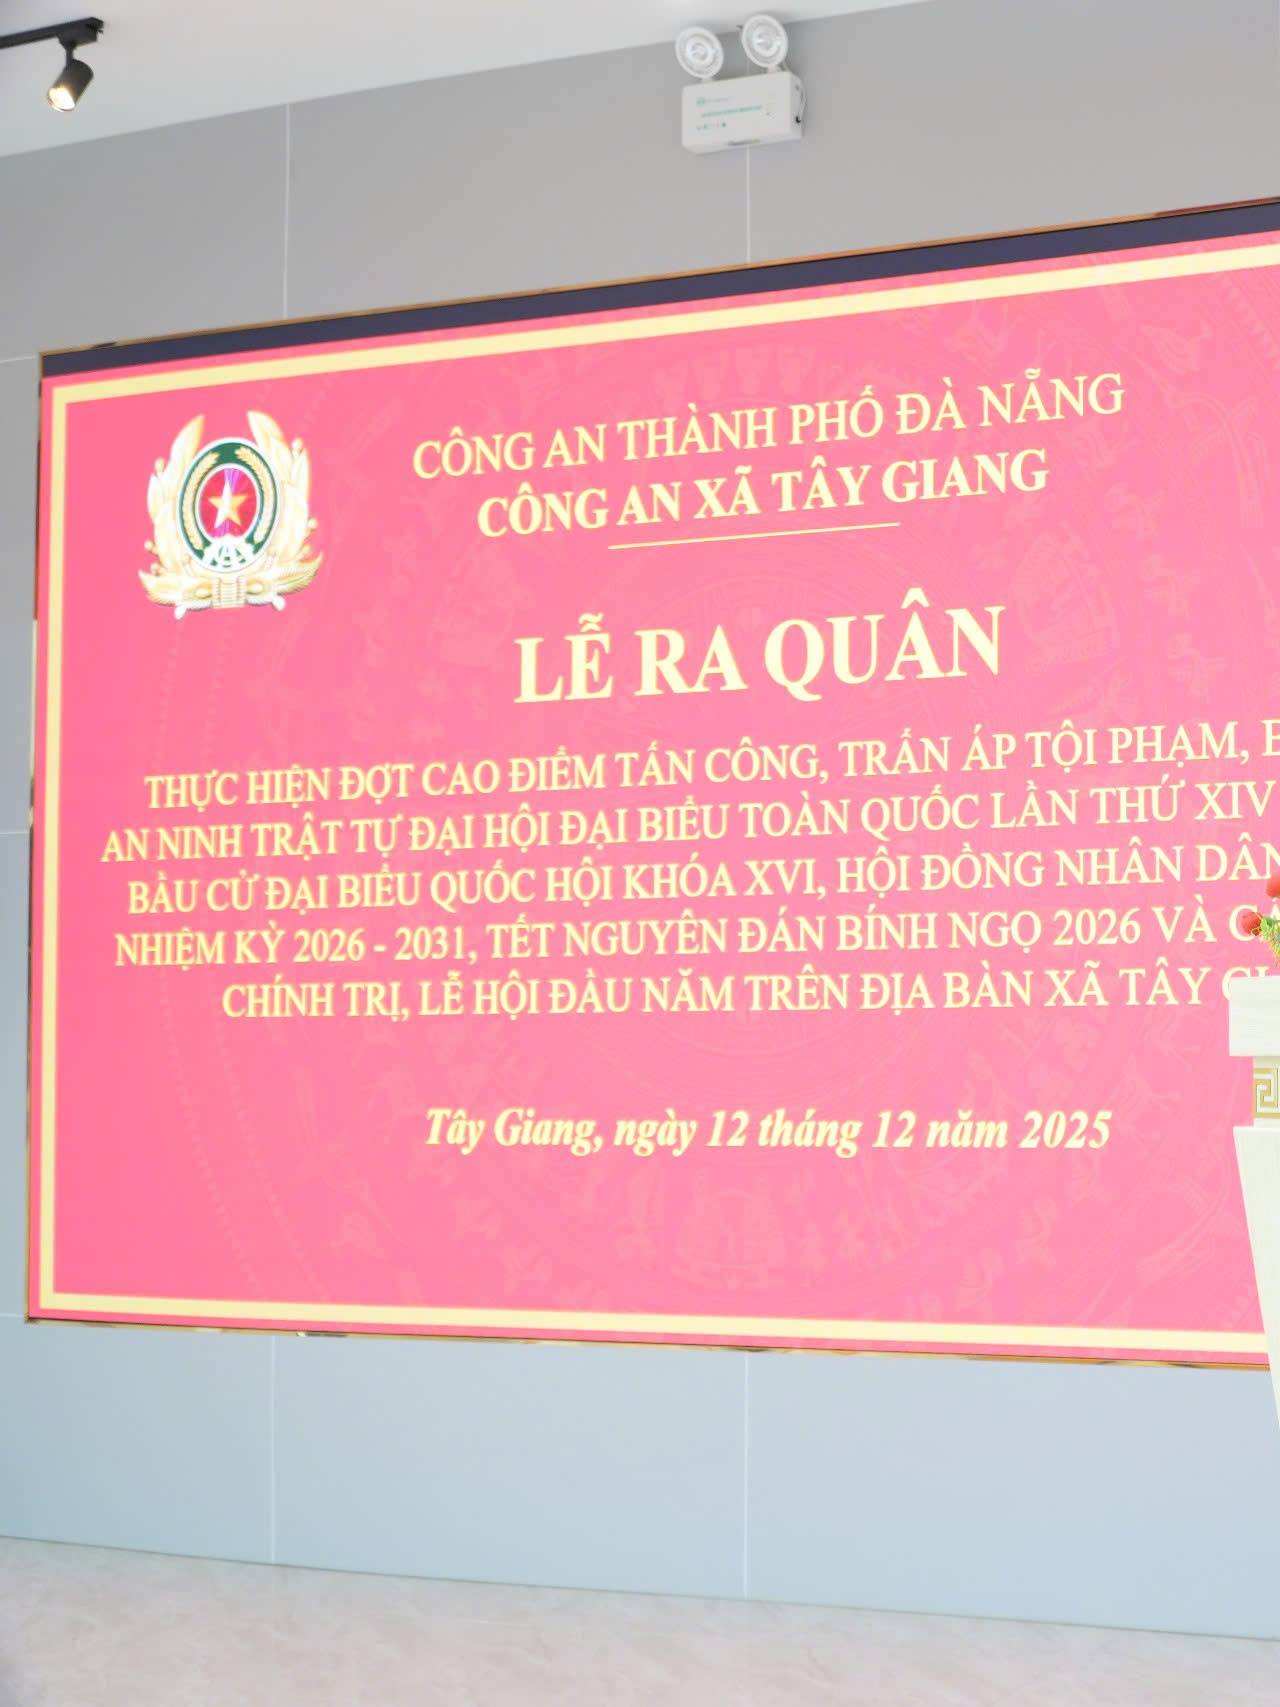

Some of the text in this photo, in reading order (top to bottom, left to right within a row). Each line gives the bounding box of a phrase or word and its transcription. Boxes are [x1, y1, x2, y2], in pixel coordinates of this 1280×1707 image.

[414, 368, 1123, 478] CÔNG AN THÀNH PHỐ ĐÀ NẴNG
[478, 448, 1048, 537] CÔNG AN XÃ TÂY GIANG
[515, 587, 1005, 703] LỄ RA QUÂN
[145, 770, 238, 812] THỰC
[247, 764, 331, 808] HIỆN
[339, 763, 414, 804] ĐỢT
[422, 760, 500, 795] CAO
[510, 746, 606, 792] ĐIỂM
[615, 741, 695, 787] TẤN
[705, 736, 829, 784] CÔNG,
[838, 729, 949, 776] TRẤN
[963, 724, 1016, 771] ÁP
[1025, 719, 1097, 773] TỘI
[1111, 721, 1248, 768] PHẠM,
[102, 829, 149, 862] AN
[157, 824, 242, 860] NINH
[251, 812, 343, 860] TRẬT
[351, 814, 403, 858] TỰ
[409, 815, 474, 856] ĐẠI
[484, 802, 550, 853] HỘI
[560, 808, 628, 849] ĐẠI
[639, 795, 729, 841] BIỂU
[739, 790, 851, 837] TOÀN
[861, 784, 979, 841] QUỐC
[992, 780, 1079, 828] LẦN
[1089, 775, 1184, 824] THỨ
[1196, 780, 1276, 820] XIV
[129, 872, 198, 913] BẦU
[207, 869, 260, 911] CỬ
[265, 875, 328, 915] ĐẠI
[338, 864, 422, 908] BIỂU
[431, 859, 536, 912] QUỐC
[546, 856, 612, 907] HỘI
[624, 852, 736, 899] KHÓA
[746, 859, 826, 899] XVI,
[839, 846, 911, 898] HỘI
[922, 842, 1044, 890] ĐỒNG
[1056, 836, 1184, 886] NHÂN
[116, 928, 224, 970] NHIỆM
[235, 920, 285, 963] KỲ
[294, 928, 365, 962] 2026
[395, 926, 477, 964] 2031,
[486, 913, 555, 958] TẾT
[563, 908, 728, 957] NGUYÊN
[739, 906, 824, 952] ĐÁN
[836, 904, 937, 950] BÍNH
[948, 910, 1042, 952] NGỌ
[1054, 908, 1141, 946] 2026
[1152, 894, 1216, 943] VÀ
[223, 974, 334, 1017] CHÍNH
[343, 982, 409, 1021] TRỊ,
[419, 971, 464, 1015] LỄ
[474, 969, 539, 1020] HỘI
[549, 968, 632, 1013] ĐẦU
[643, 968, 735, 1012] NĂM
[744, 964, 849, 1010] TRÊN
[860, 972, 934, 1015] ĐỊA
[944, 960, 1032, 1008] BÀN
[1045, 960, 1108, 1006] XÃ
[1119, 956, 1210, 1005] TÂY
[426, 1107, 1112, 1158] Tây Giang, ngày 12 tháng 12 năm 2025
